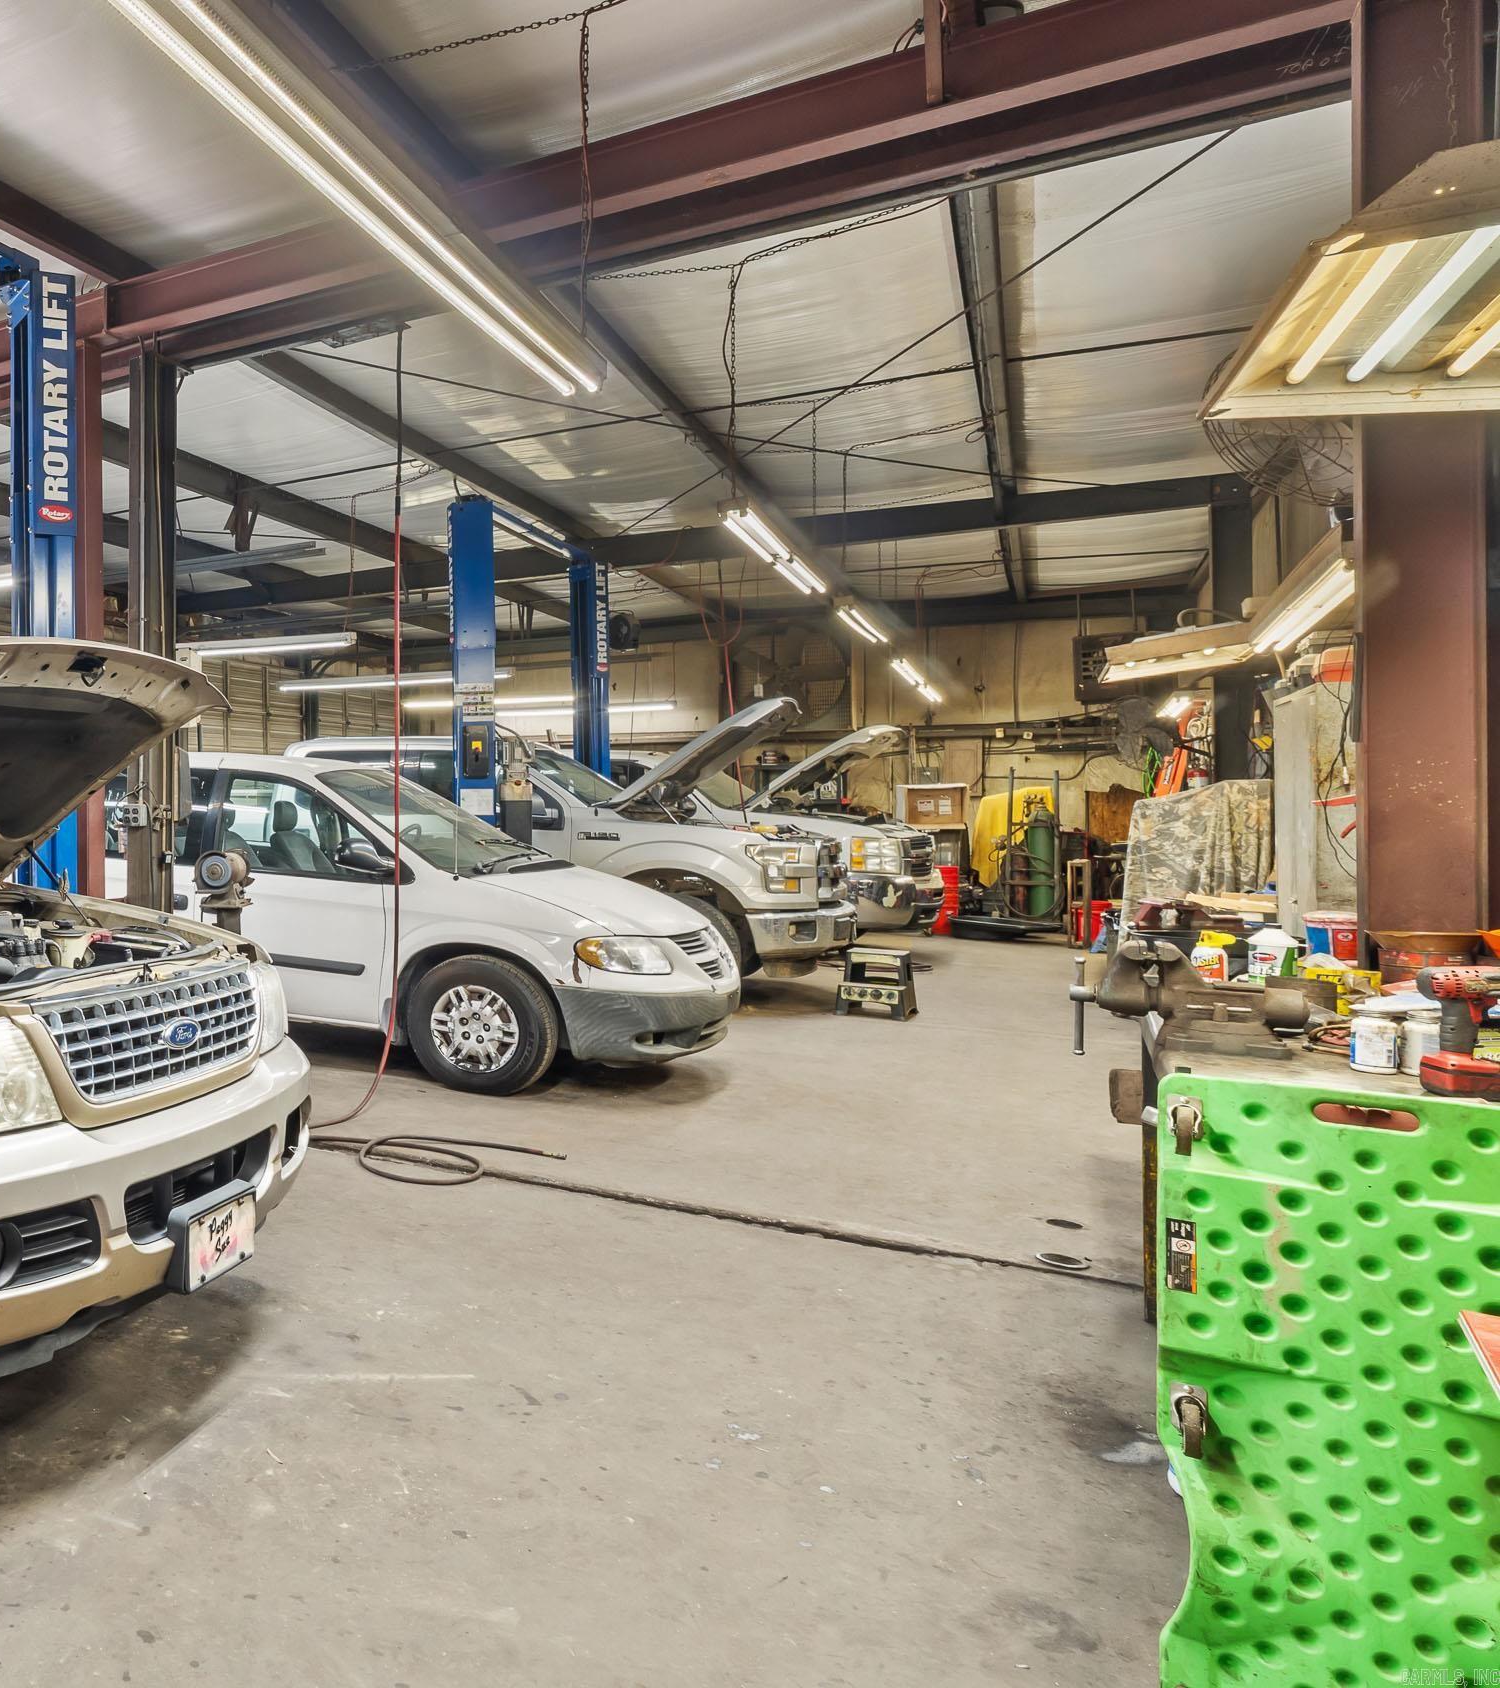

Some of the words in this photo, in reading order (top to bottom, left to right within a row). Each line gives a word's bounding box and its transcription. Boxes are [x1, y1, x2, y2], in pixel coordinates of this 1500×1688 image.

[42, 276, 68, 350] LIFT
[43, 359, 69, 502] ROTARY
[41, 505, 72, 521] Rotary
[595, 562, 606, 596] LIFT
[596, 600, 607, 663] ROTARY
[175, 1026, 194, 1044] Ford
